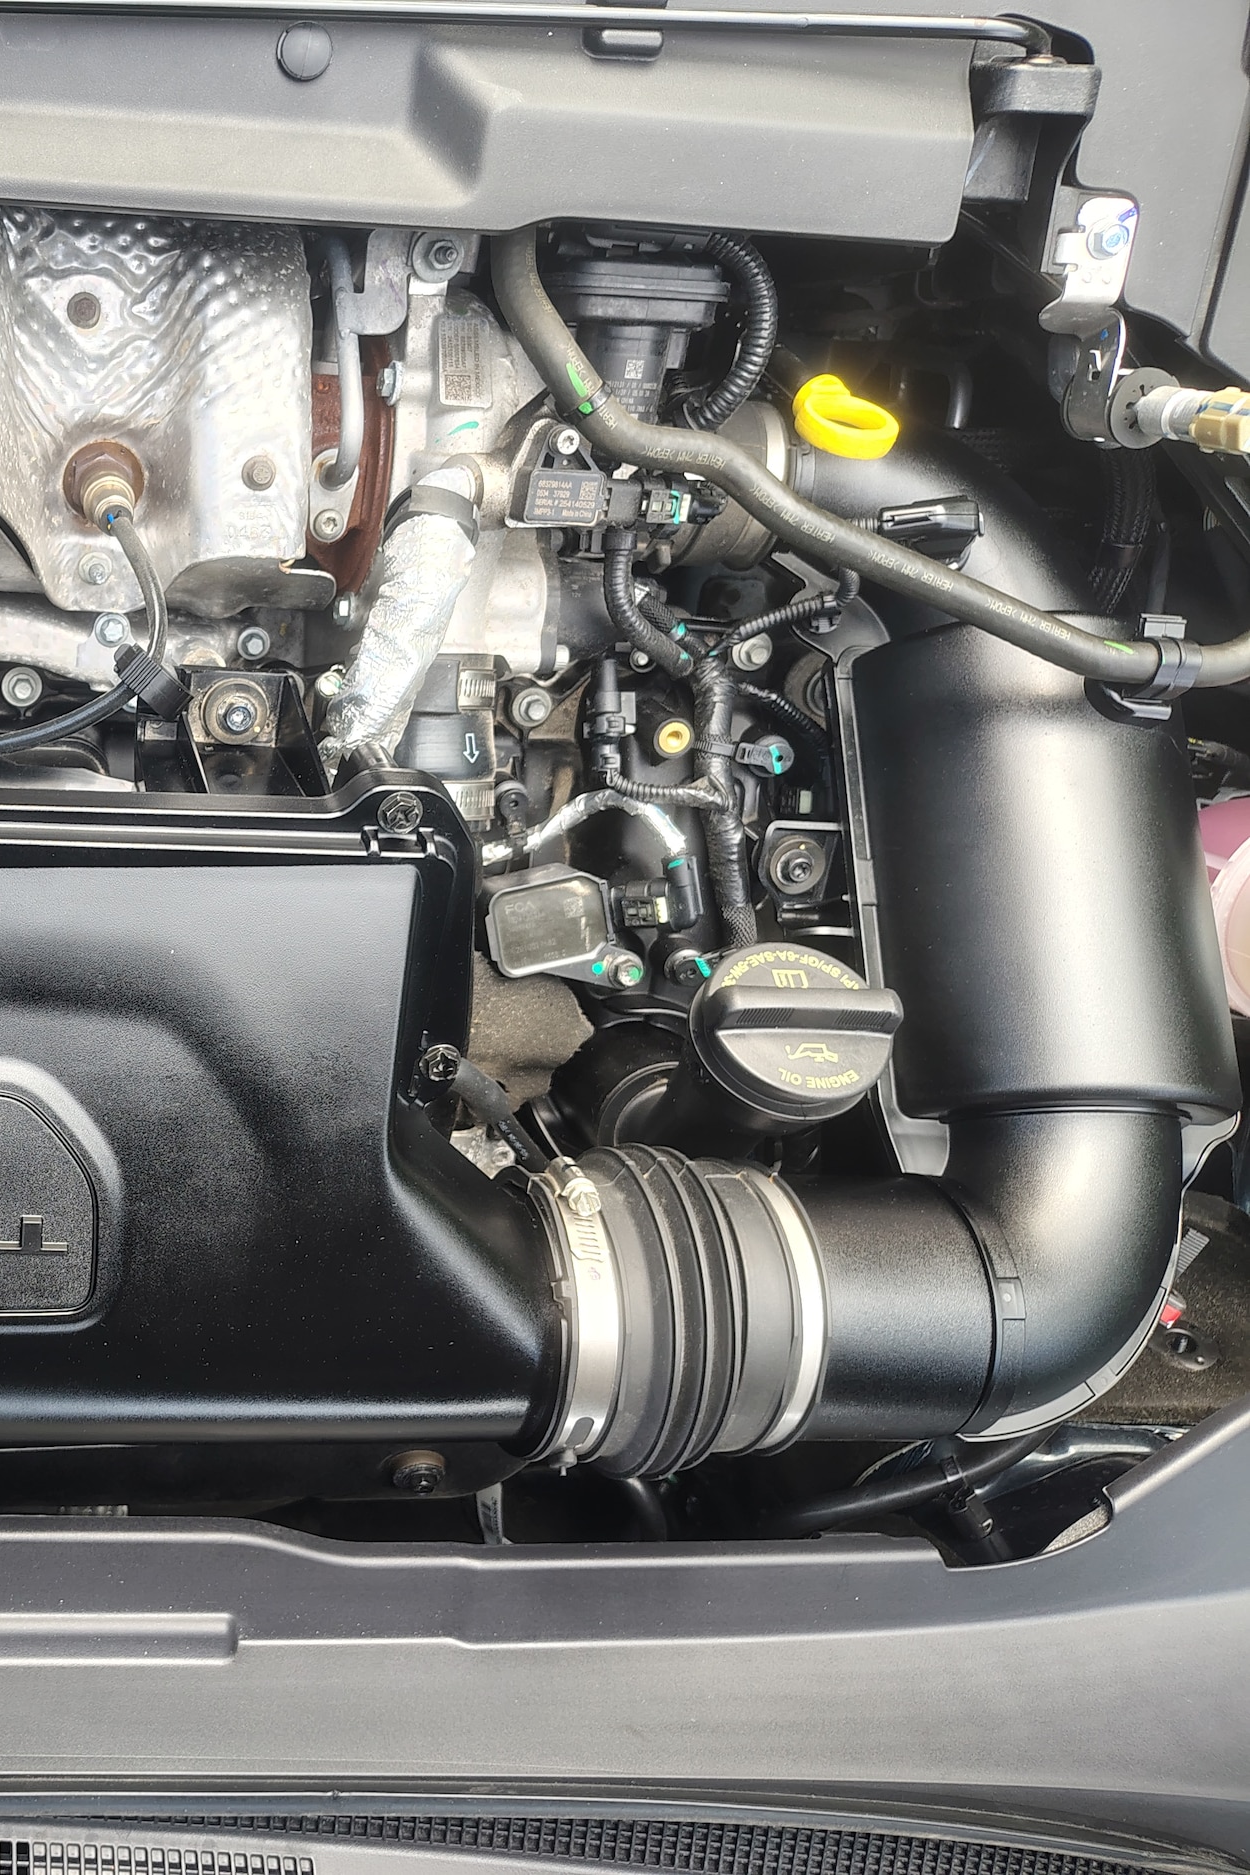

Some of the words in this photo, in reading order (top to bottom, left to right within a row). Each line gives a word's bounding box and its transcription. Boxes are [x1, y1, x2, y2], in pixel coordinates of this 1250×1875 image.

[696, 453, 726, 470] HEATER
[800, 520, 836, 543] HEATER
[921, 570, 954, 592] HEATER
[1039, 620, 1071, 641] HEATER
[505, 901, 535, 914] FCA
[777, 1067, 802, 1085] OIL
[805, 1069, 860, 1089] ENGINE
